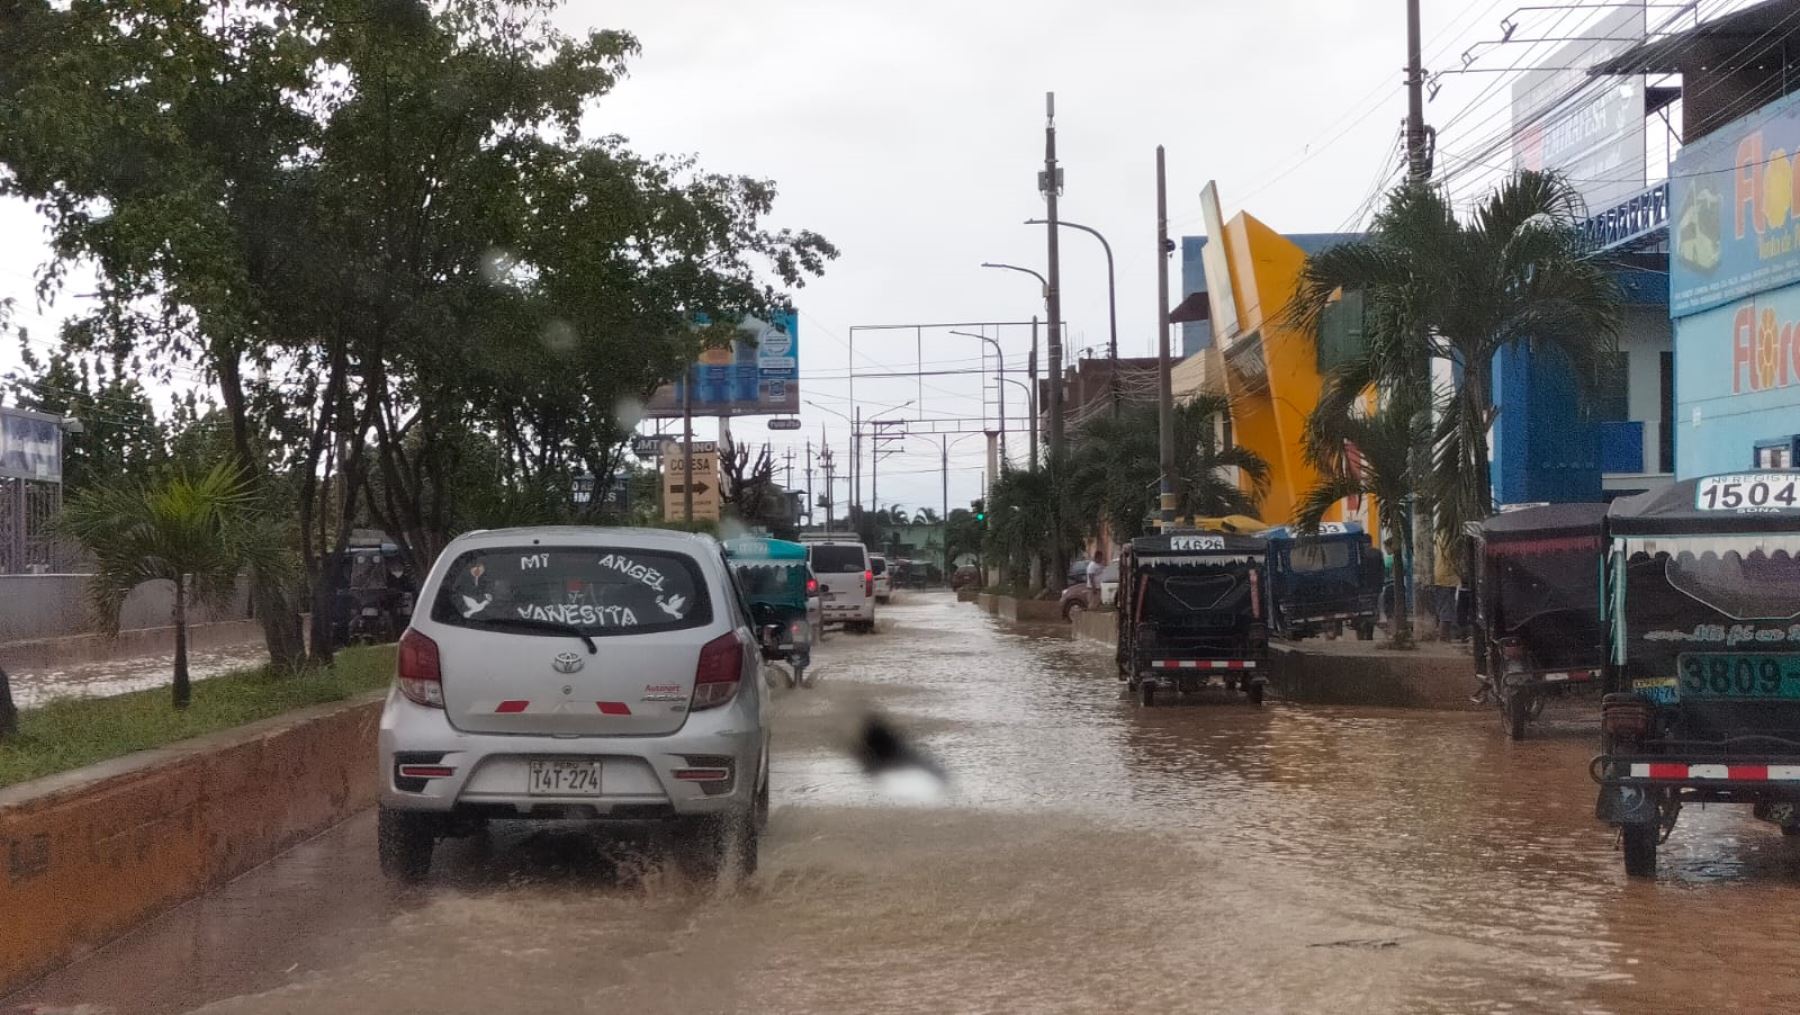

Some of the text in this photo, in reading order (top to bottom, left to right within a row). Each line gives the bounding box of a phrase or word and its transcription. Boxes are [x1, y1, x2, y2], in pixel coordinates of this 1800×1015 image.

[670, 458, 711, 471] COESA
[1702, 482, 1797, 509] 1504
[1173, 540, 1223, 550] 14626
[521, 553, 665, 592] MI ANGEL
[517, 604, 638, 627] VANESITA
[533, 769, 598, 789] T4T-274
